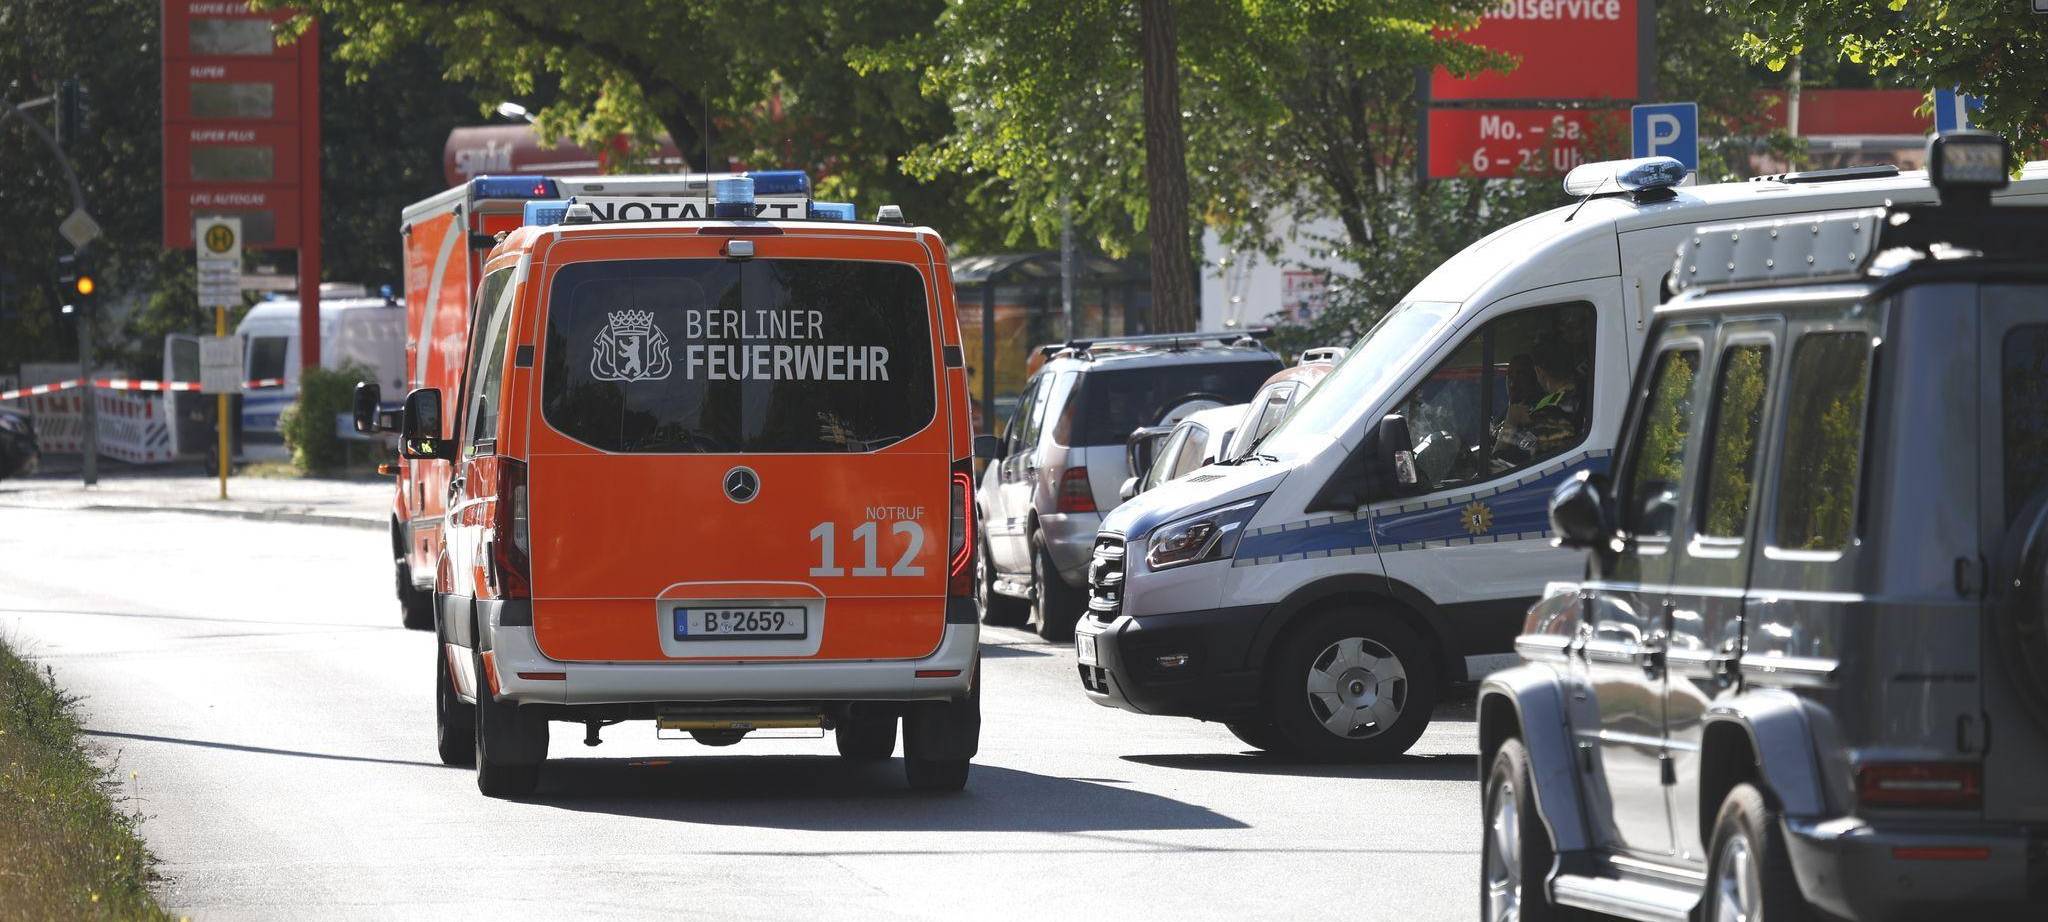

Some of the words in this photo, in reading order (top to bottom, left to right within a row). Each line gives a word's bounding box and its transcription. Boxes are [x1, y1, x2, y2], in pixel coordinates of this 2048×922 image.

[190, 66, 225, 78] SUPER
[190, 129, 225, 142] SUPER
[1480, 115, 1522, 140] Mo.
[1647, 114, 1681, 158] P
[1472, 147, 1489, 172] 6
[686, 309, 824, 339] BERLINER
[686, 344, 890, 381] FEUERWEHR
[866, 506, 925, 520] NOTRUF
[809, 520, 925, 577] 112
[704, 612, 718, 632] B
[733, 611, 785, 632] 2659
